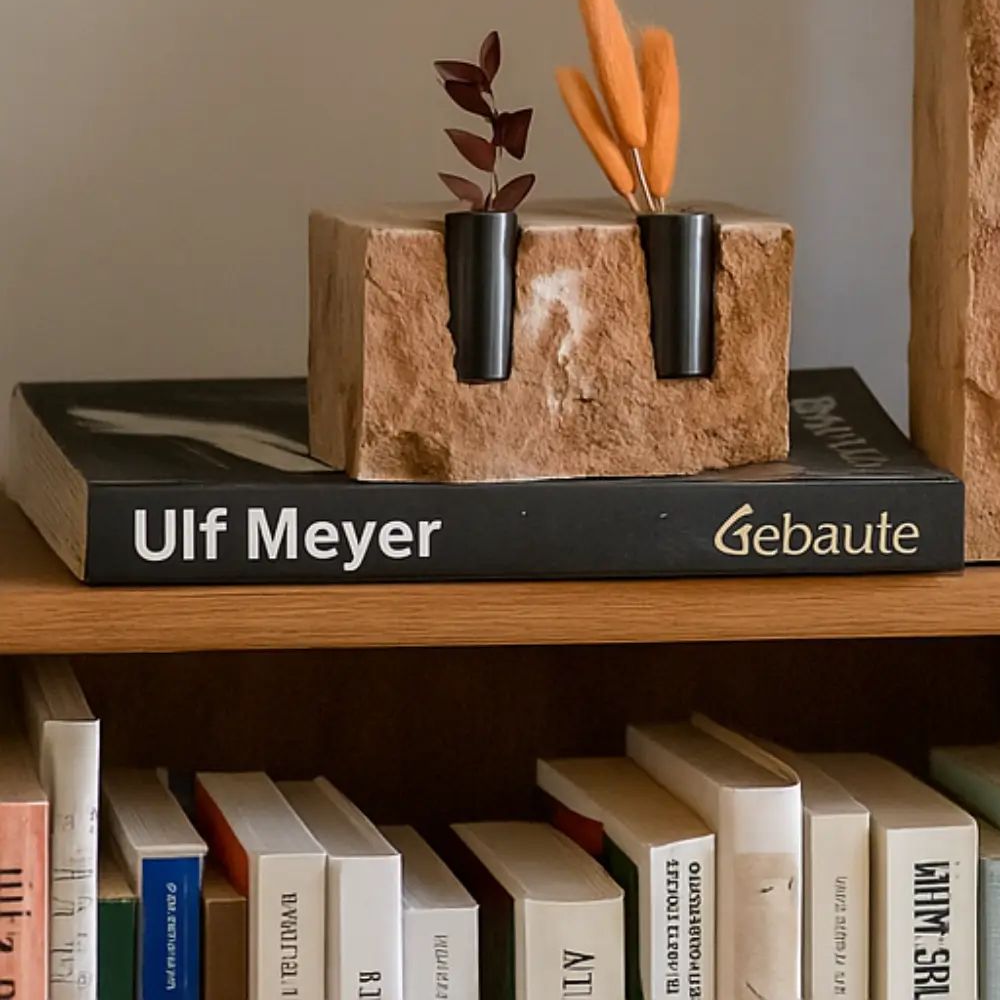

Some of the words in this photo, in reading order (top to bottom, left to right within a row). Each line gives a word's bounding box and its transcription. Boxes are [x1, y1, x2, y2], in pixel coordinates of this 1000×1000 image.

[134, 507, 228, 562] Ulf
[247, 507, 443, 572] Meyer
[714, 503, 920, 556] Gebaute
